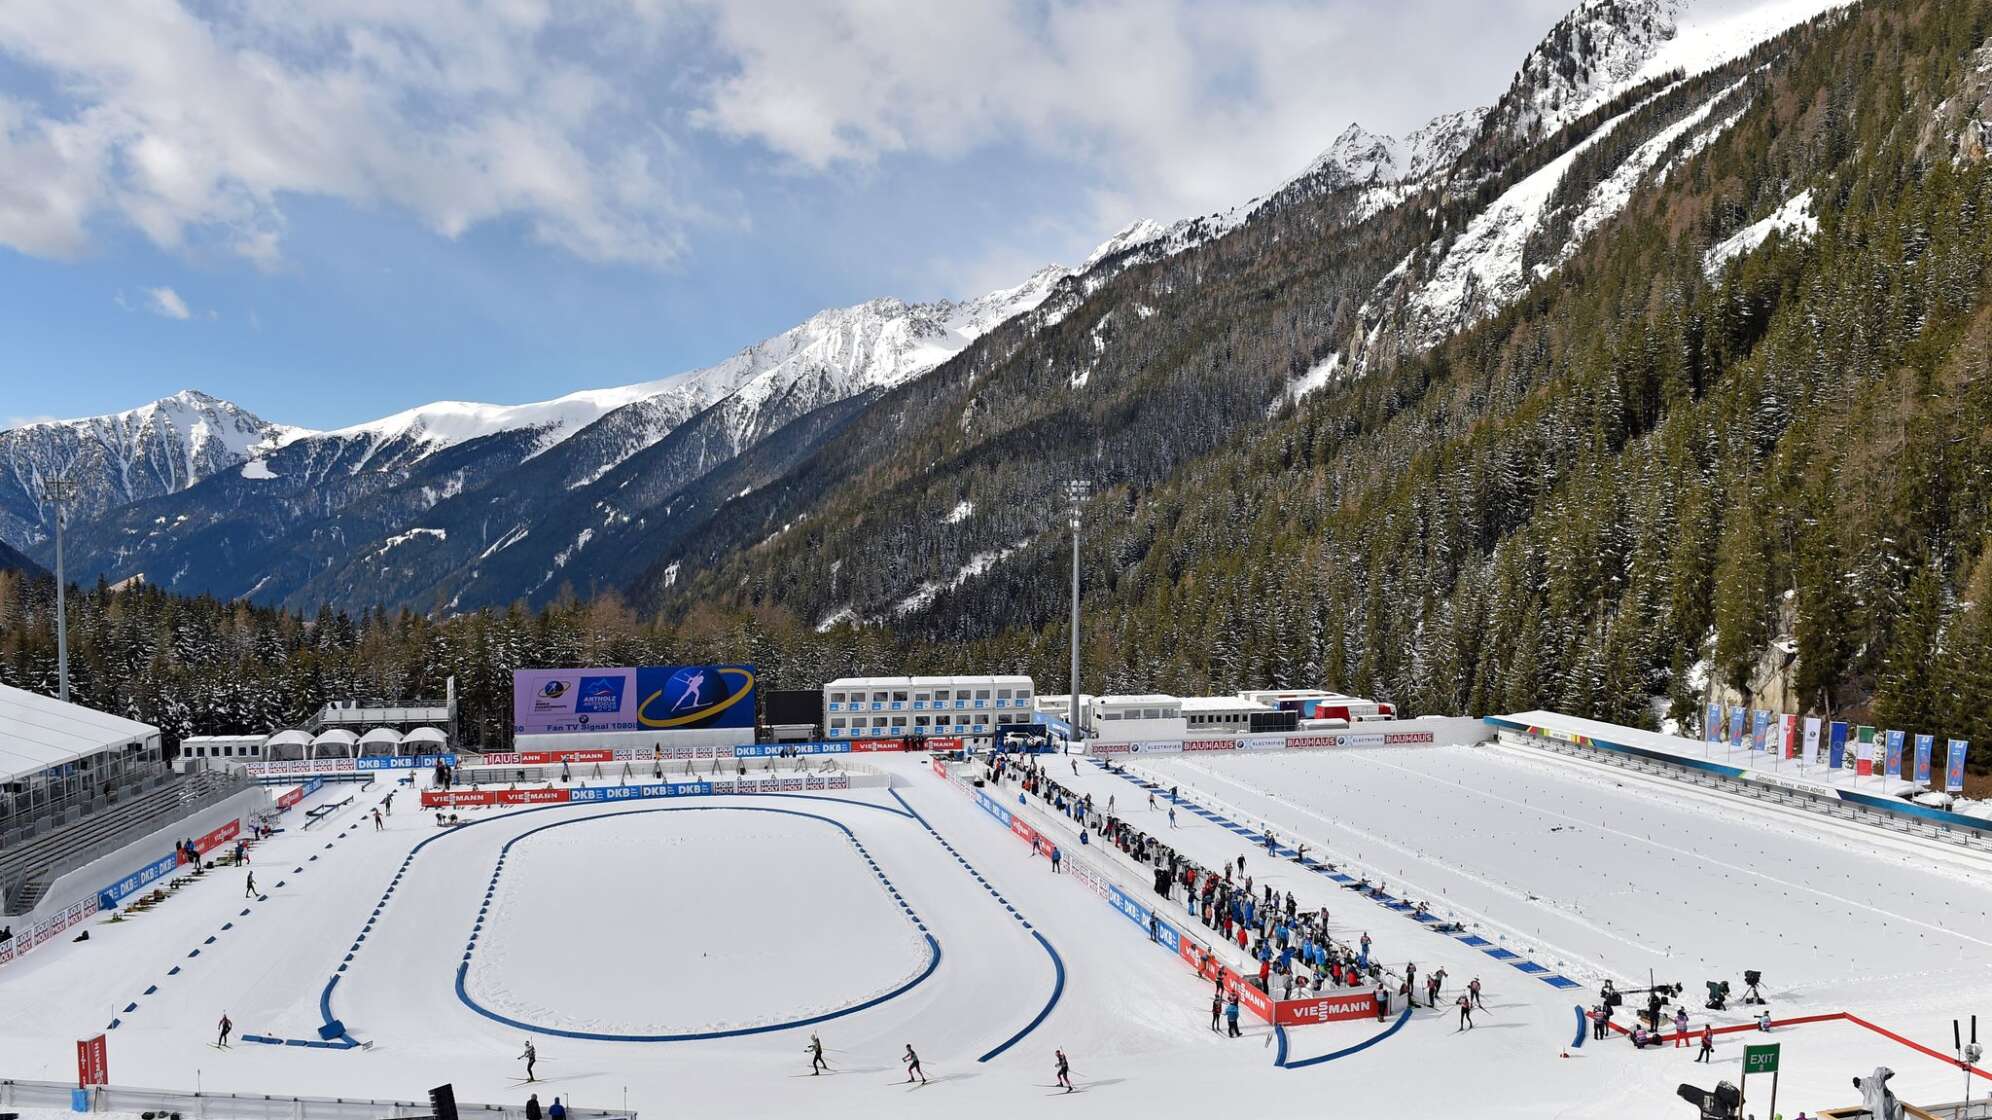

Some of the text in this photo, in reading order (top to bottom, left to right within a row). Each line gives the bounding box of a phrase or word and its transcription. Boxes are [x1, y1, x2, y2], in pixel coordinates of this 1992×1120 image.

[582, 723, 609, 732] Signal
[1288, 737, 1336, 747] BAUHAUS
[1386, 734, 1432, 743] BAUHAUS
[736, 747, 755, 755] DKB
[822, 744, 840, 752] DKB
[860, 741, 898, 751] VIESSMANN
[1184, 741, 1234, 750] BAUHAUS
[358, 758, 380, 768] DKB
[391, 758, 412, 767] DKB
[607, 788, 630, 798] DKB
[643, 786, 666, 796] DKB
[678, 785, 700, 794] DKB
[432, 793, 484, 804] VIESSMANN
[508, 792, 557, 803] VIESSMANN
[572, 790, 595, 800] DKB
[159, 858, 172, 874] DKB
[141, 869, 154, 883] DKB
[120, 878, 134, 895] DKB
[1160, 923, 1173, 944] DKB
[1229, 978, 1266, 1010] VIESSMANN
[1293, 1000, 1370, 1021] VIESSMANN
[1750, 1053, 1775, 1065] EXIT
